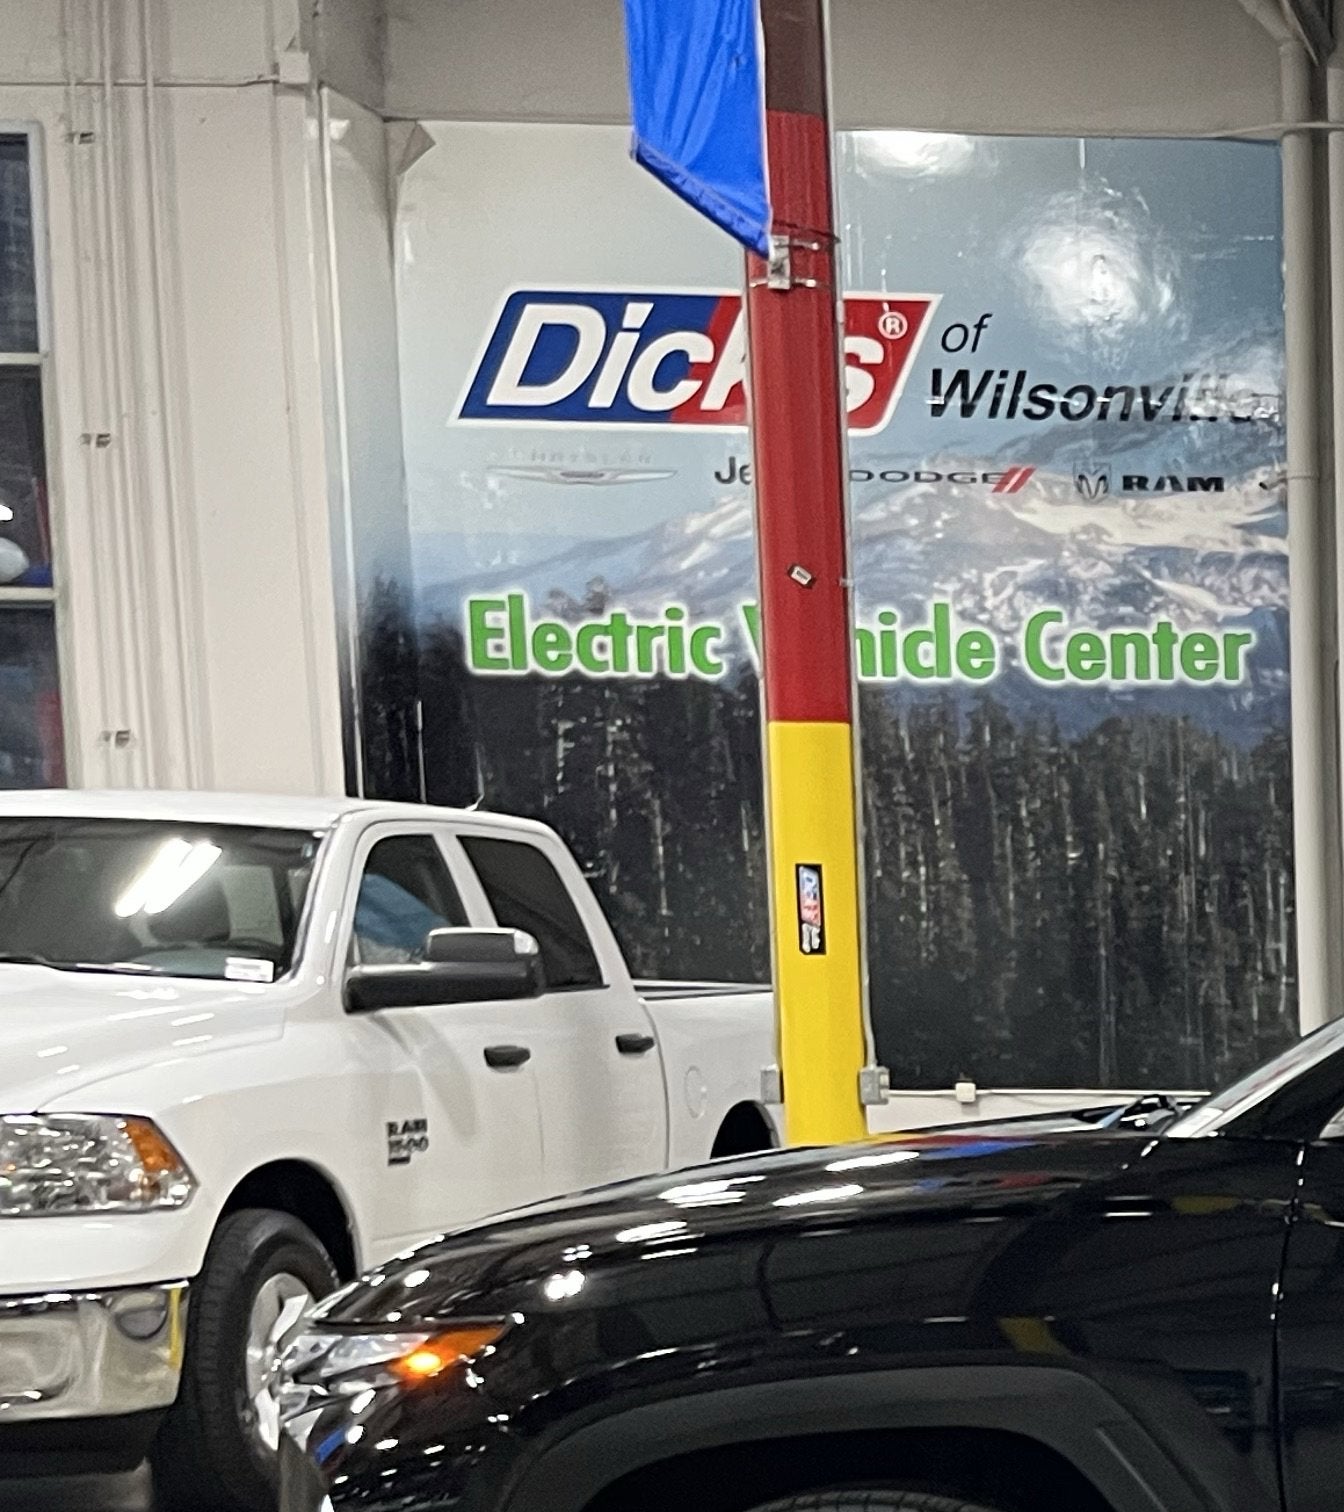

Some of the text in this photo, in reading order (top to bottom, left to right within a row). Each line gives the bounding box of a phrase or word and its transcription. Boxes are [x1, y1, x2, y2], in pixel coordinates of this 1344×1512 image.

[940, 313, 993, 353] of
[929, 368, 1264, 422] Wilsonvi
[1122, 475, 1225, 492] RAM
[469, 594, 723, 675] Electric
[1024, 610, 1252, 681] Center
[386, 1118, 428, 1137] RAM
